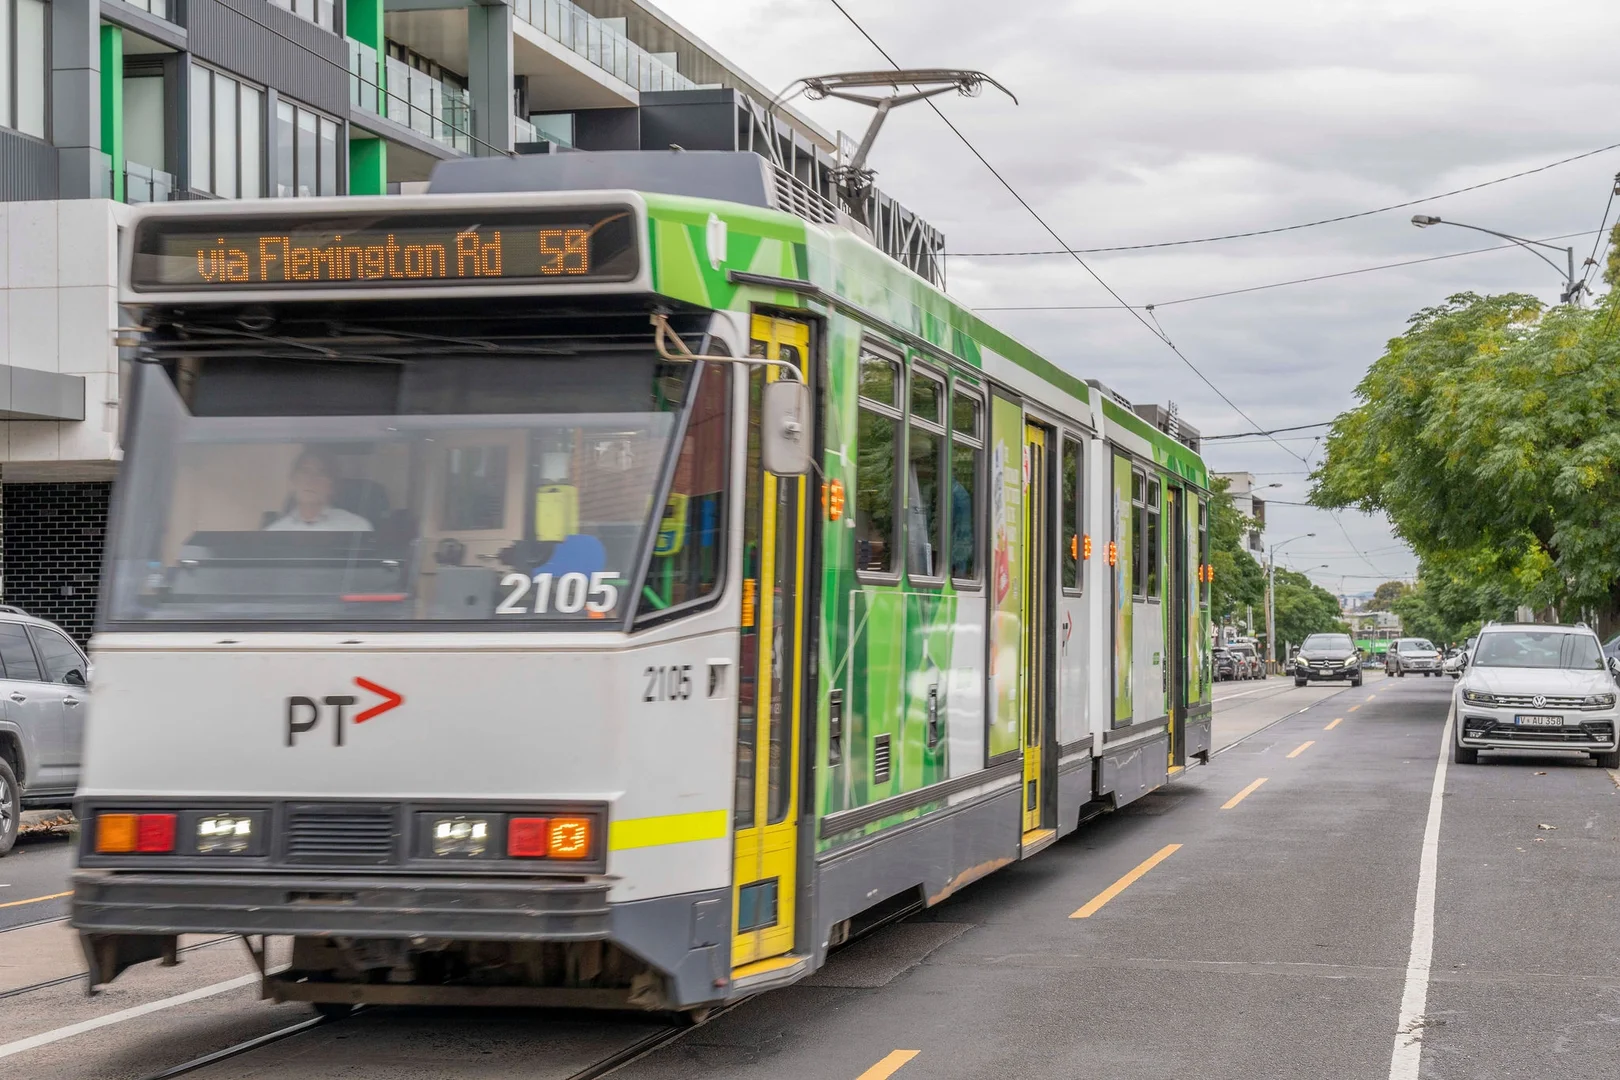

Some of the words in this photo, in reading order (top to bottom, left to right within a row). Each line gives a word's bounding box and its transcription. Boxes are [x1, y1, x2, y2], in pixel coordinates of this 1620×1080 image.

[197, 237, 249, 282] via
[259, 233, 446, 281] Flemington
[457, 231, 501, 276] Rd
[540, 229, 588, 274] 59
[495, 571, 621, 614] 2105
[642, 665, 693, 702] 2105
